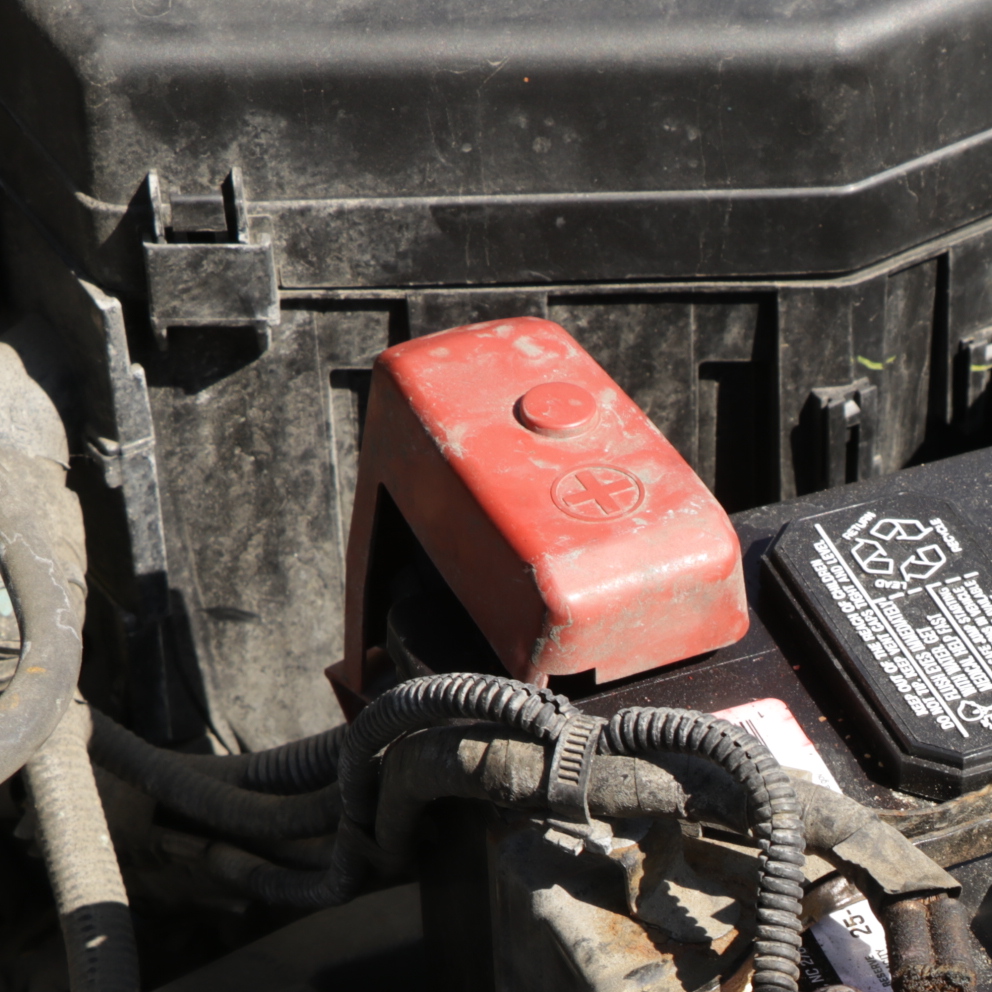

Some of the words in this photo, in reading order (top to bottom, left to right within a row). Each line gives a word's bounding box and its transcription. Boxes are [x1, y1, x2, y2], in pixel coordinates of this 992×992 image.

[842, 511, 877, 540] RETURN
[929, 517, 962, 553] RECYCLE
[813, 538, 840, 565] LEVEL
[810, 558, 847, 600] CHILDREN
[829, 564, 853, 583] AND
[874, 577, 907, 590] LEAD
[837, 599, 856, 613] OF
[842, 582, 871, 609] TIGHT
[937, 586, 972, 624] STARTING
[951, 585, 982, 617] VEHICLE
[846, 612, 876, 642] REACH
[860, 607, 888, 632] CAPS
[877, 599, 926, 652] IMMEDIATELY
[925, 612, 953, 634] FAST
[973, 615, 989, 626] IN
[876, 631, 904, 655] VENT
[915, 625, 941, 644] GET
[941, 634, 969, 656] HELP
[963, 623, 987, 645] JUMP
[866, 641, 888, 660] THE
[879, 659, 898, 674] OF
[893, 654, 920, 678] KEEP
[913, 651, 942, 675] EYES
[889, 674, 912, 693] OUT
[908, 677, 932, 696] TIP.
[928, 672, 961, 701] FLUSH
[949, 673, 978, 698] WITH
[903, 692, 929, 716] KEEP
[921, 696, 944, 715] NOT
[935, 714, 955, 730] DO
[804, 967, 825, 984] NC
[865, 954, 891, 987] RESERVE
